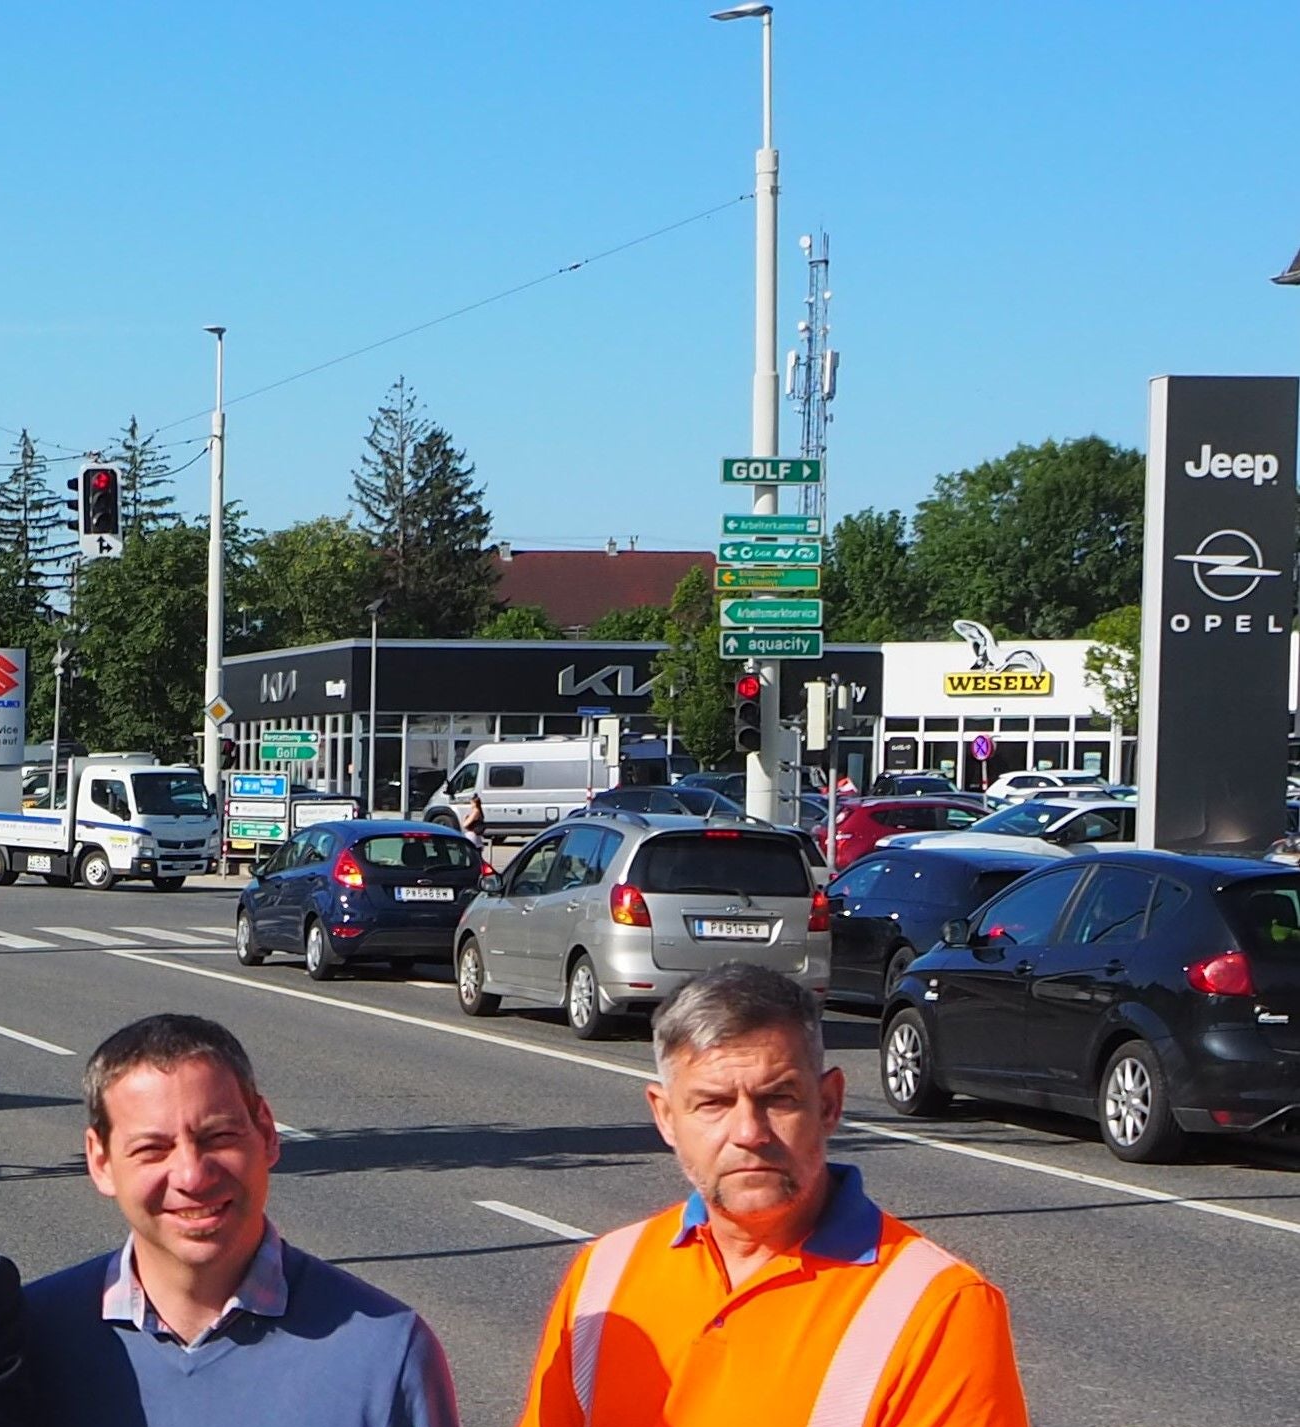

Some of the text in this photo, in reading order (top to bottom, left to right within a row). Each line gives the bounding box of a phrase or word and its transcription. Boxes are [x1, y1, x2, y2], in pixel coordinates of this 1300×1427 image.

[732, 462, 791, 479] GOLF
[1185, 444, 1279, 486] Jeep
[1170, 614, 1283, 633] OPEL
[748, 637, 810, 654] aquacity
[948, 674, 1048, 691] WESELY
[276, 745, 297, 758] Golf
